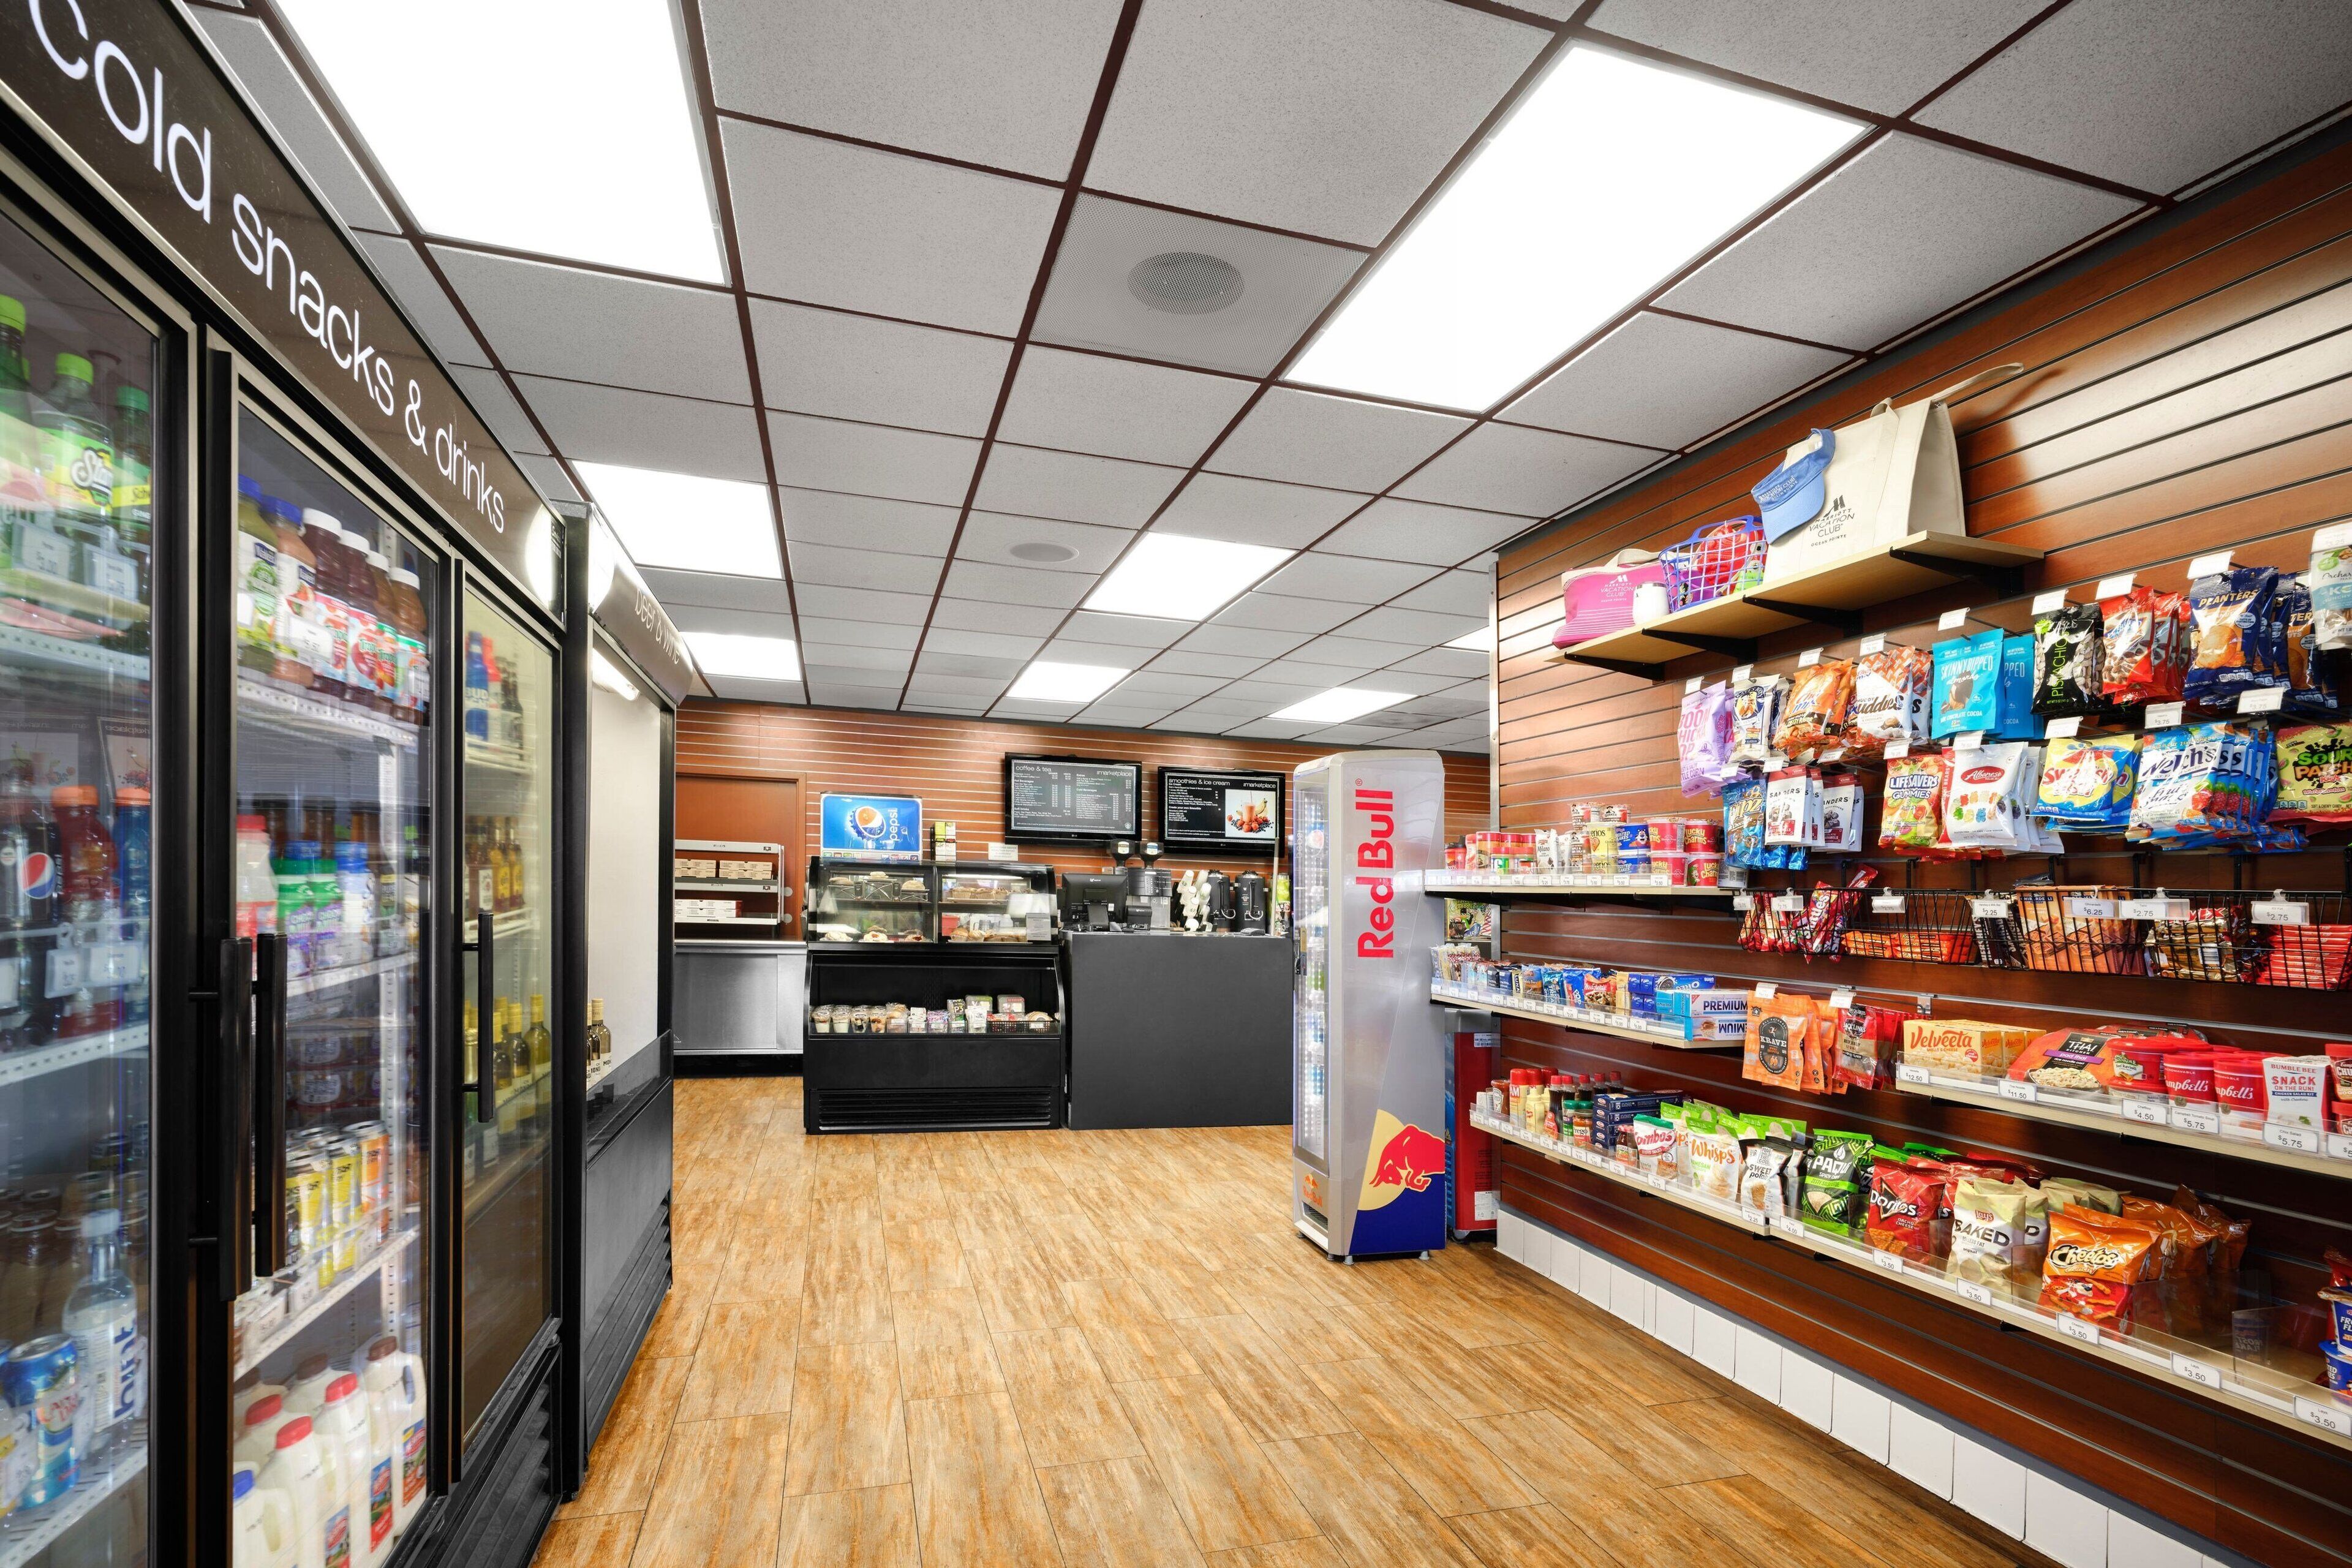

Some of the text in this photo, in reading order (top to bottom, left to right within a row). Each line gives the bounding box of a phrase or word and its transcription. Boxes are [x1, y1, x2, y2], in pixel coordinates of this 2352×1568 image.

[232, 193, 395, 417] snacks
[405, 379, 428, 456] &
[435, 423, 505, 533] drinks
[1782, 475, 1796, 489] CLUB
[1815, 508, 1852, 522] MARRIOTT
[1809, 513, 1855, 532] VACATION
[1817, 524, 1842, 538] CLUB
[1829, 533, 1847, 542] POINTE
[2322, 570, 2352, 580] Orchar
[2199, 589, 2259, 608] PLANTERS
[2297, 746, 2352, 766] SOUR
[1966, 769, 2002, 782] Albanese
[2294, 761, 2352, 780] PATCH
[1892, 789, 1931, 799] GUMMIES
[889, 807, 900, 842] pepsi
[1355, 790, 1395, 959] Red Bull
[1983, 908, 1998, 916] $2.25
[2084, 907, 2103, 916] $6.25
[2133, 908, 2154, 917] $2.75
[2267, 911, 2289, 921] $2.75
[1703, 1000, 1748, 1011] PREMIUM
[1760, 1035, 1787, 1048] KRAVE
[1910, 1026, 1973, 1050] Velveeta
[2068, 1041, 2098, 1052] THAI
[2271, 1063, 2301, 1072] BUMBLE
[1906, 1072, 1923, 1082] $12.50
[2271, 1076, 2316, 1086] SNACK
[1509, 1085, 1520, 1096] AM
[2008, 1089, 2027, 1099] $11.50
[2215, 1085, 2254, 1100] mpbell's
[2134, 1109, 2154, 1121] $4.50
[2184, 1117, 2205, 1130] $5.75
[2277, 1135, 2302, 1148] $5.75
[1691, 1138, 1736, 1164] Whisps
[1749, 1164, 1773, 1174] SWEET
[1870, 1189, 1917, 1217] Doritos
[1747, 1215, 1758, 1223] $2.25
[1895, 1221, 1915, 1230] CHEESE
[1897, 1217, 1915, 1226] NACHO
[1786, 1224, 1798, 1235] $4.00
[1954, 1219, 2010, 1247] BAKED
[2050, 1245, 2121, 1269] Cheetos
[1881, 1259, 1894, 1270] $3.50
[1967, 1289, 1982, 1302] $3.50
[2069, 1325, 2087, 1340] $3.50
[2184, 1366, 2206, 1382] $3.50
[2310, 1411, 2336, 1429] $3.50
